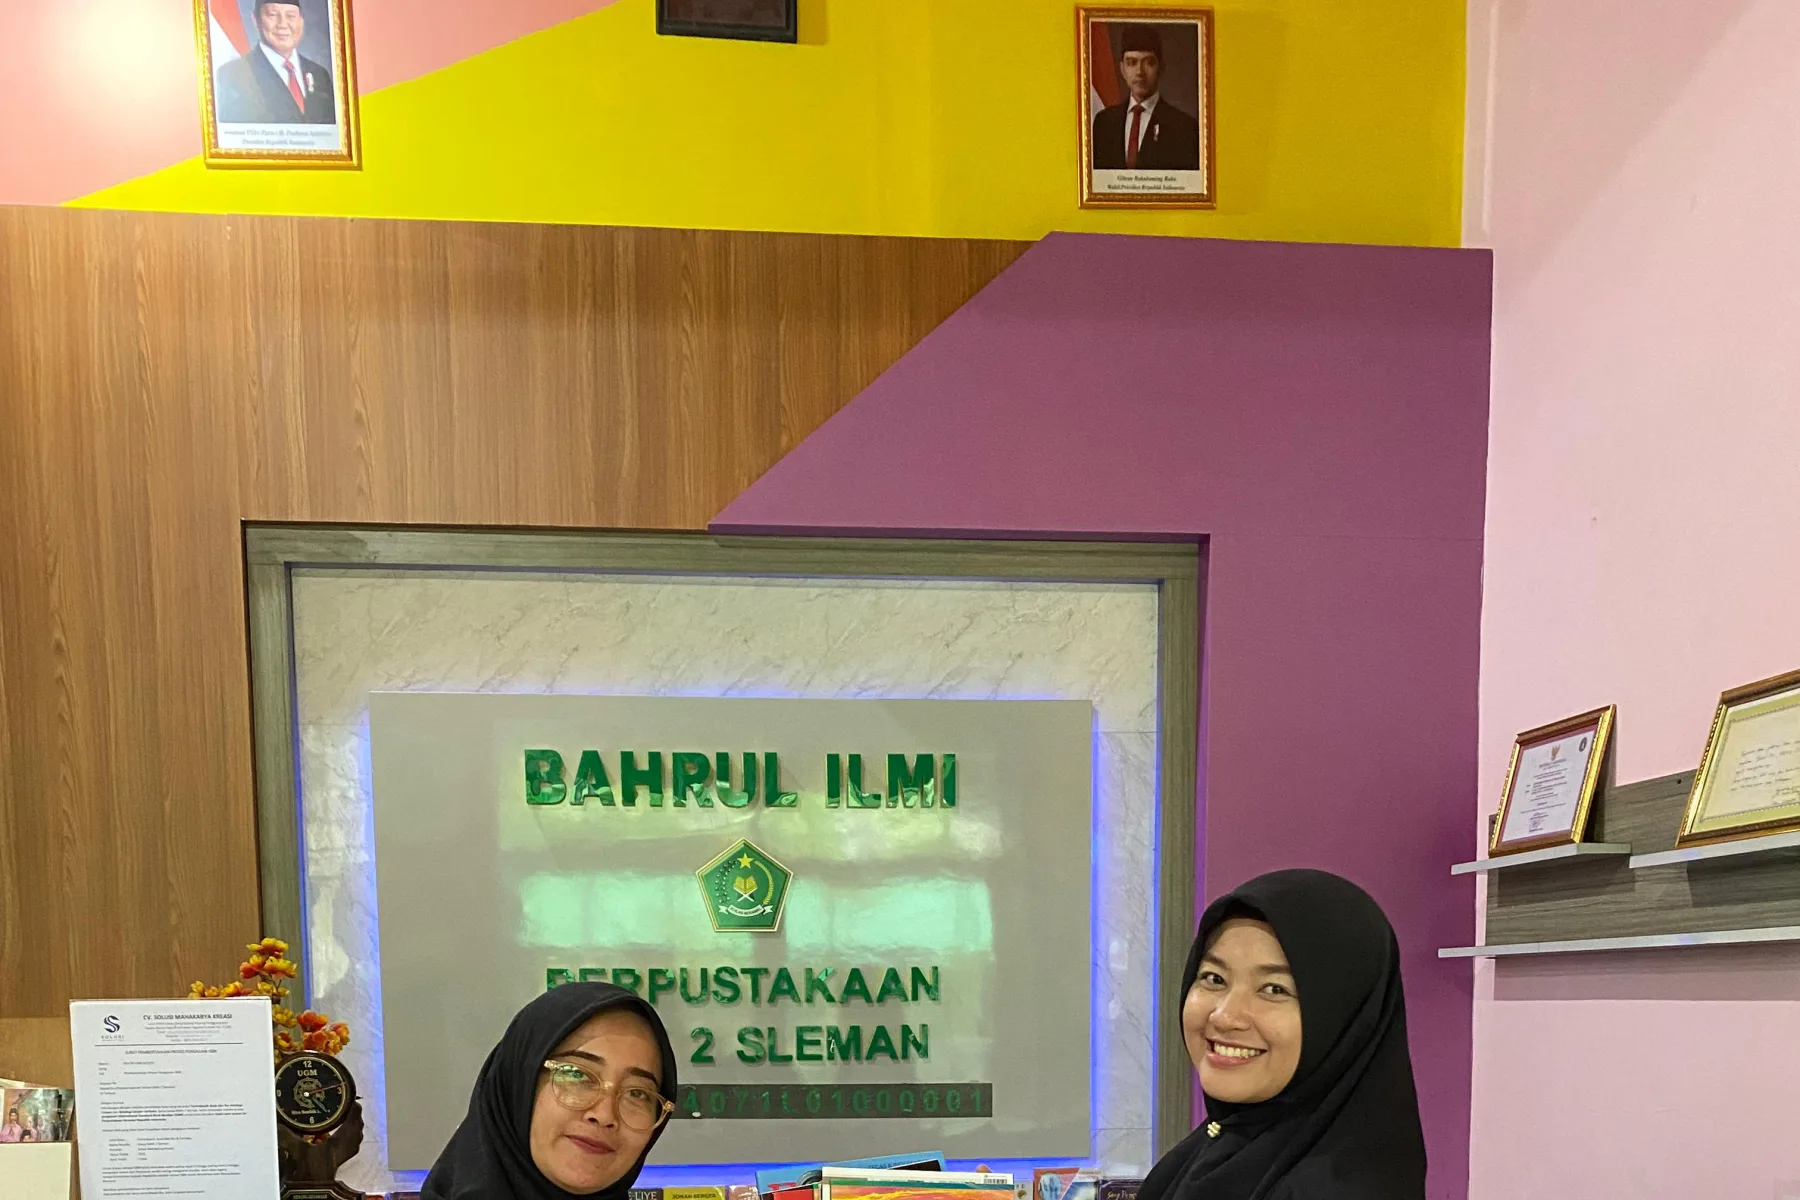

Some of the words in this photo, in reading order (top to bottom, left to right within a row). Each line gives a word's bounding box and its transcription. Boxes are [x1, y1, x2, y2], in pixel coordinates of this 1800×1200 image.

[524, 749, 798, 807] BAHRUL
[825, 752, 957, 808] ILMI
[690, 1026, 714, 1063] 2
[737, 1024, 930, 1062] SLEMAN
[297, 1069, 318, 1077] UGM
[303, 1060, 313, 1068] 12
